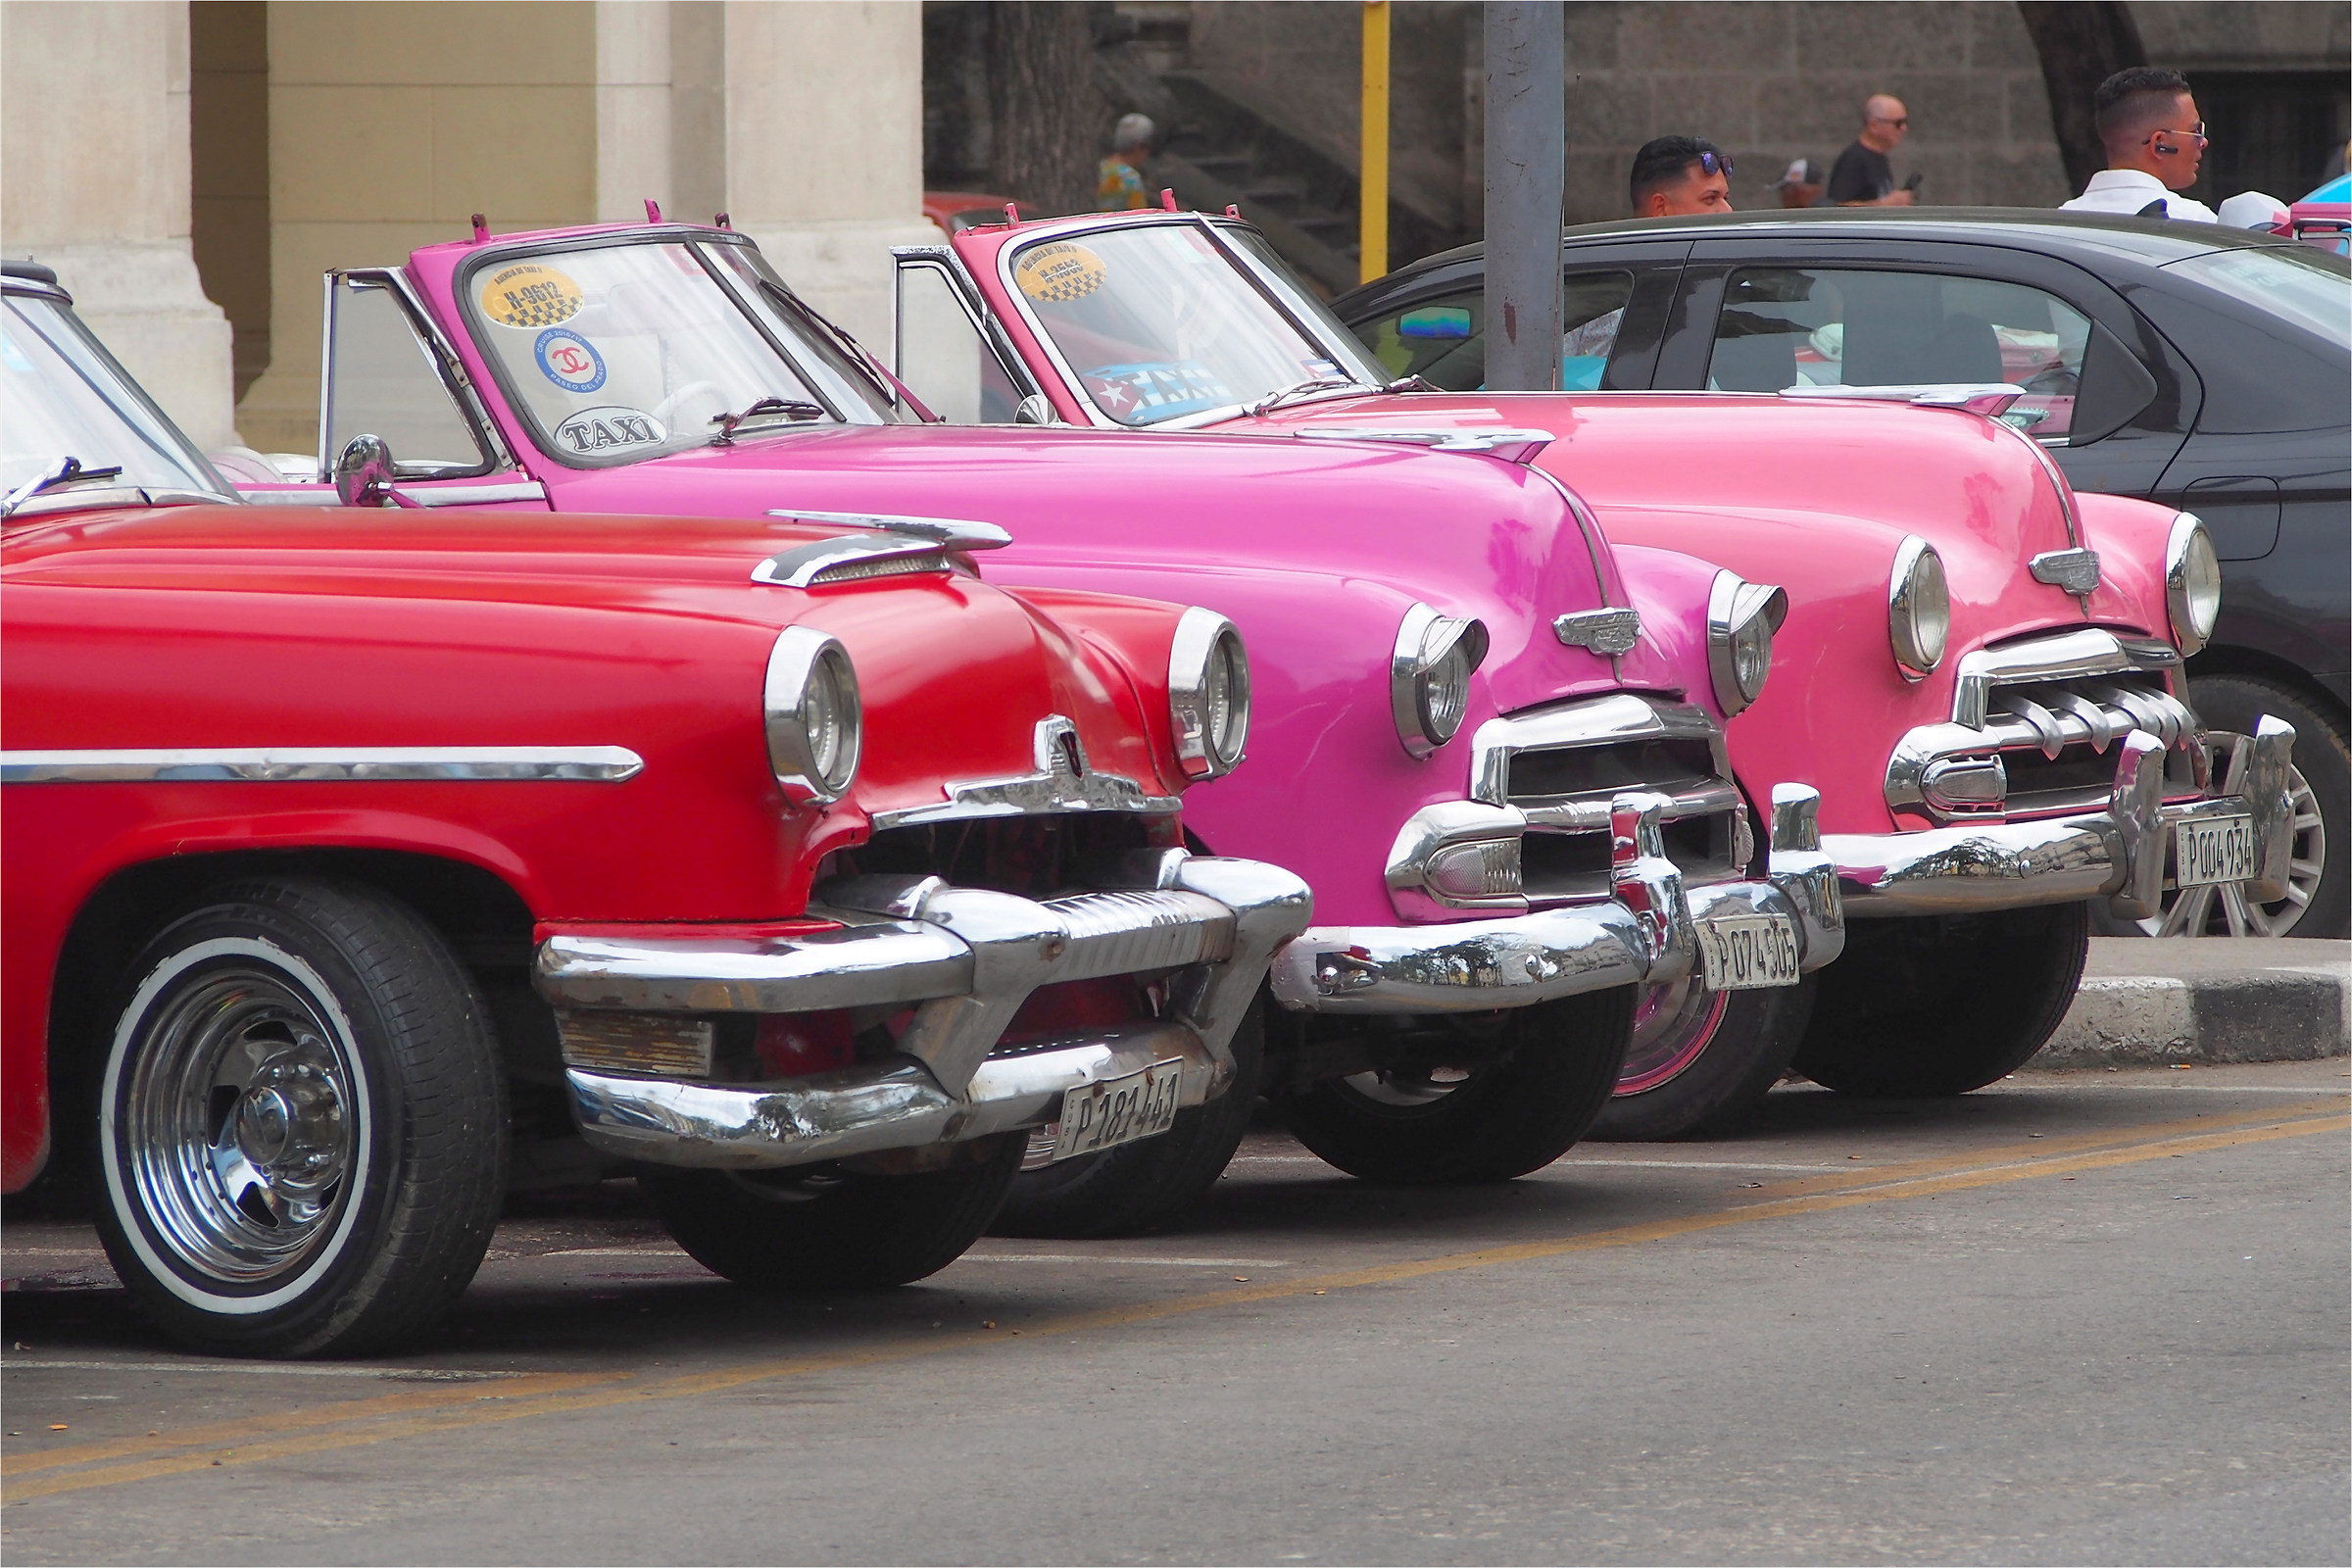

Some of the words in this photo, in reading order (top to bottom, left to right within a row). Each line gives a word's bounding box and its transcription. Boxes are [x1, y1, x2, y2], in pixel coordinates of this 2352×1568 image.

[504, 281, 564, 310] H-9612
[536, 330, 555, 354] CRUISE
[550, 372, 579, 390] PASEO
[580, 382, 597, 391] DEL
[593, 360, 605, 384] PRADO
[563, 416, 661, 452] TAXI
[2187, 827, 2252, 881] P004934
[1713, 927, 1797, 984] P074505
[1071, 1073, 1178, 1152] P181441
